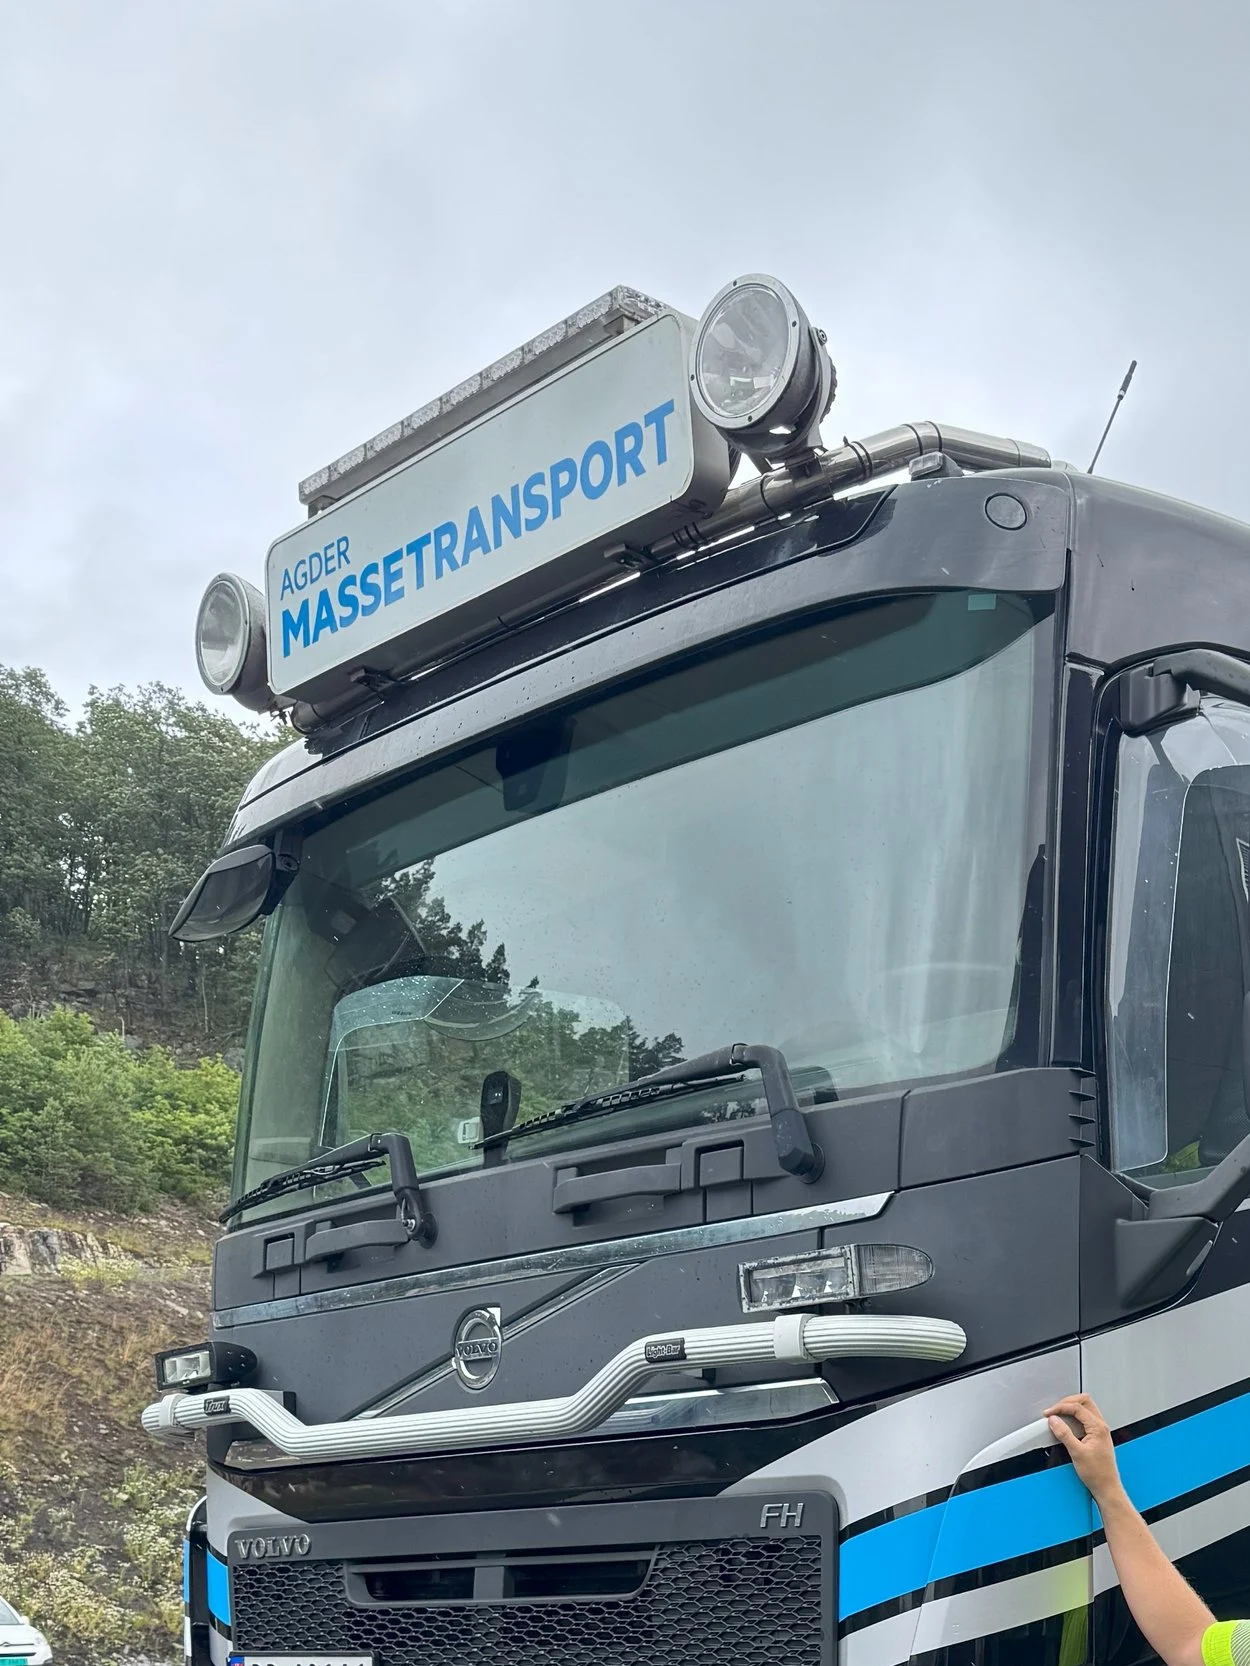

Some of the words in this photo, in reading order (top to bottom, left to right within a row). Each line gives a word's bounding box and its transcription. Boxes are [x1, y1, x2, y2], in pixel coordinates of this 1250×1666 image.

[282, 399, 675, 658] MASSETRANSPORT
[280, 535, 351, 600] AGDER
[455, 1341, 498, 1357] VOLVO
[760, 1502, 804, 1528] FH
[234, 1533, 310, 1559] VOLVO
